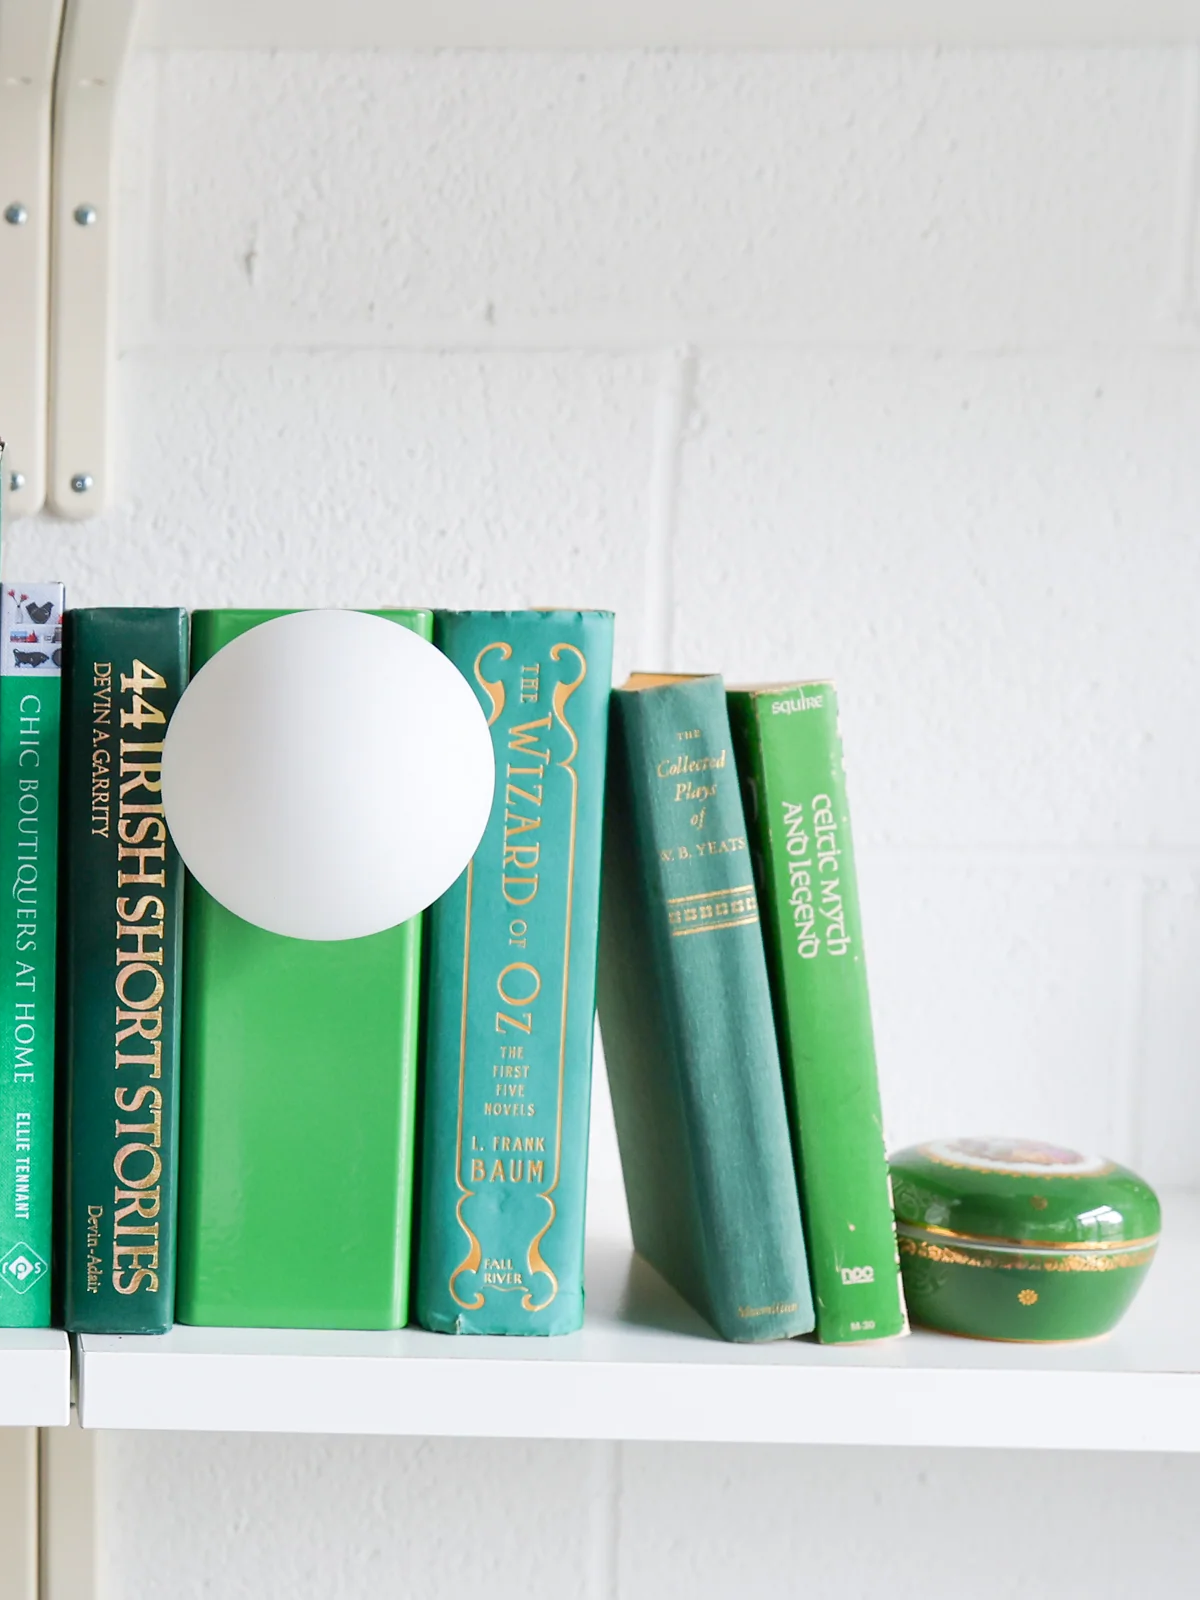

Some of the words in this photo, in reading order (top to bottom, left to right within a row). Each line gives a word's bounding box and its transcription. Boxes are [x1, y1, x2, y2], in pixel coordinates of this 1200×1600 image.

[93, 662, 111, 724] DEVIN
[120, 659, 167, 730] 44
[520, 663, 540, 703] THE
[19, 695, 41, 767] CHIC
[677, 729, 701, 740] THE
[657, 749, 726, 778] Collected
[92, 748, 111, 838] GARRITY
[675, 782, 717, 801] Plays
[118, 739, 167, 888] IRISH
[502, 711, 552, 906] WIZARD
[690, 807, 706, 830] of
[679, 846, 692, 860] B.
[696, 837, 746, 855] YEATS
[12, 779, 39, 951] BOUTIQUERS
[509, 919, 527, 949] OF
[15, 960, 36, 992] AT
[114, 895, 166, 1080] SHORT
[495, 962, 541, 1034] OZ
[14, 1003, 36, 1083] HOME
[500, 1046, 524, 1059] THE
[493, 1065, 530, 1078] FIRST
[496, 1084, 525, 1097] FIVE
[484, 1102, 536, 1117] NOVELS
[16, 1112, 31, 1151] ELLIE
[471, 1135, 484, 1151] L.
[493, 1136, 546, 1152] FRANK
[471, 1158, 545, 1183] BAUM
[15, 1156, 30, 1219] TENNANT
[112, 1086, 163, 1295] STORIES
[484, 1259, 513, 1270] FALL
[484, 1272, 522, 1284] RIVER
